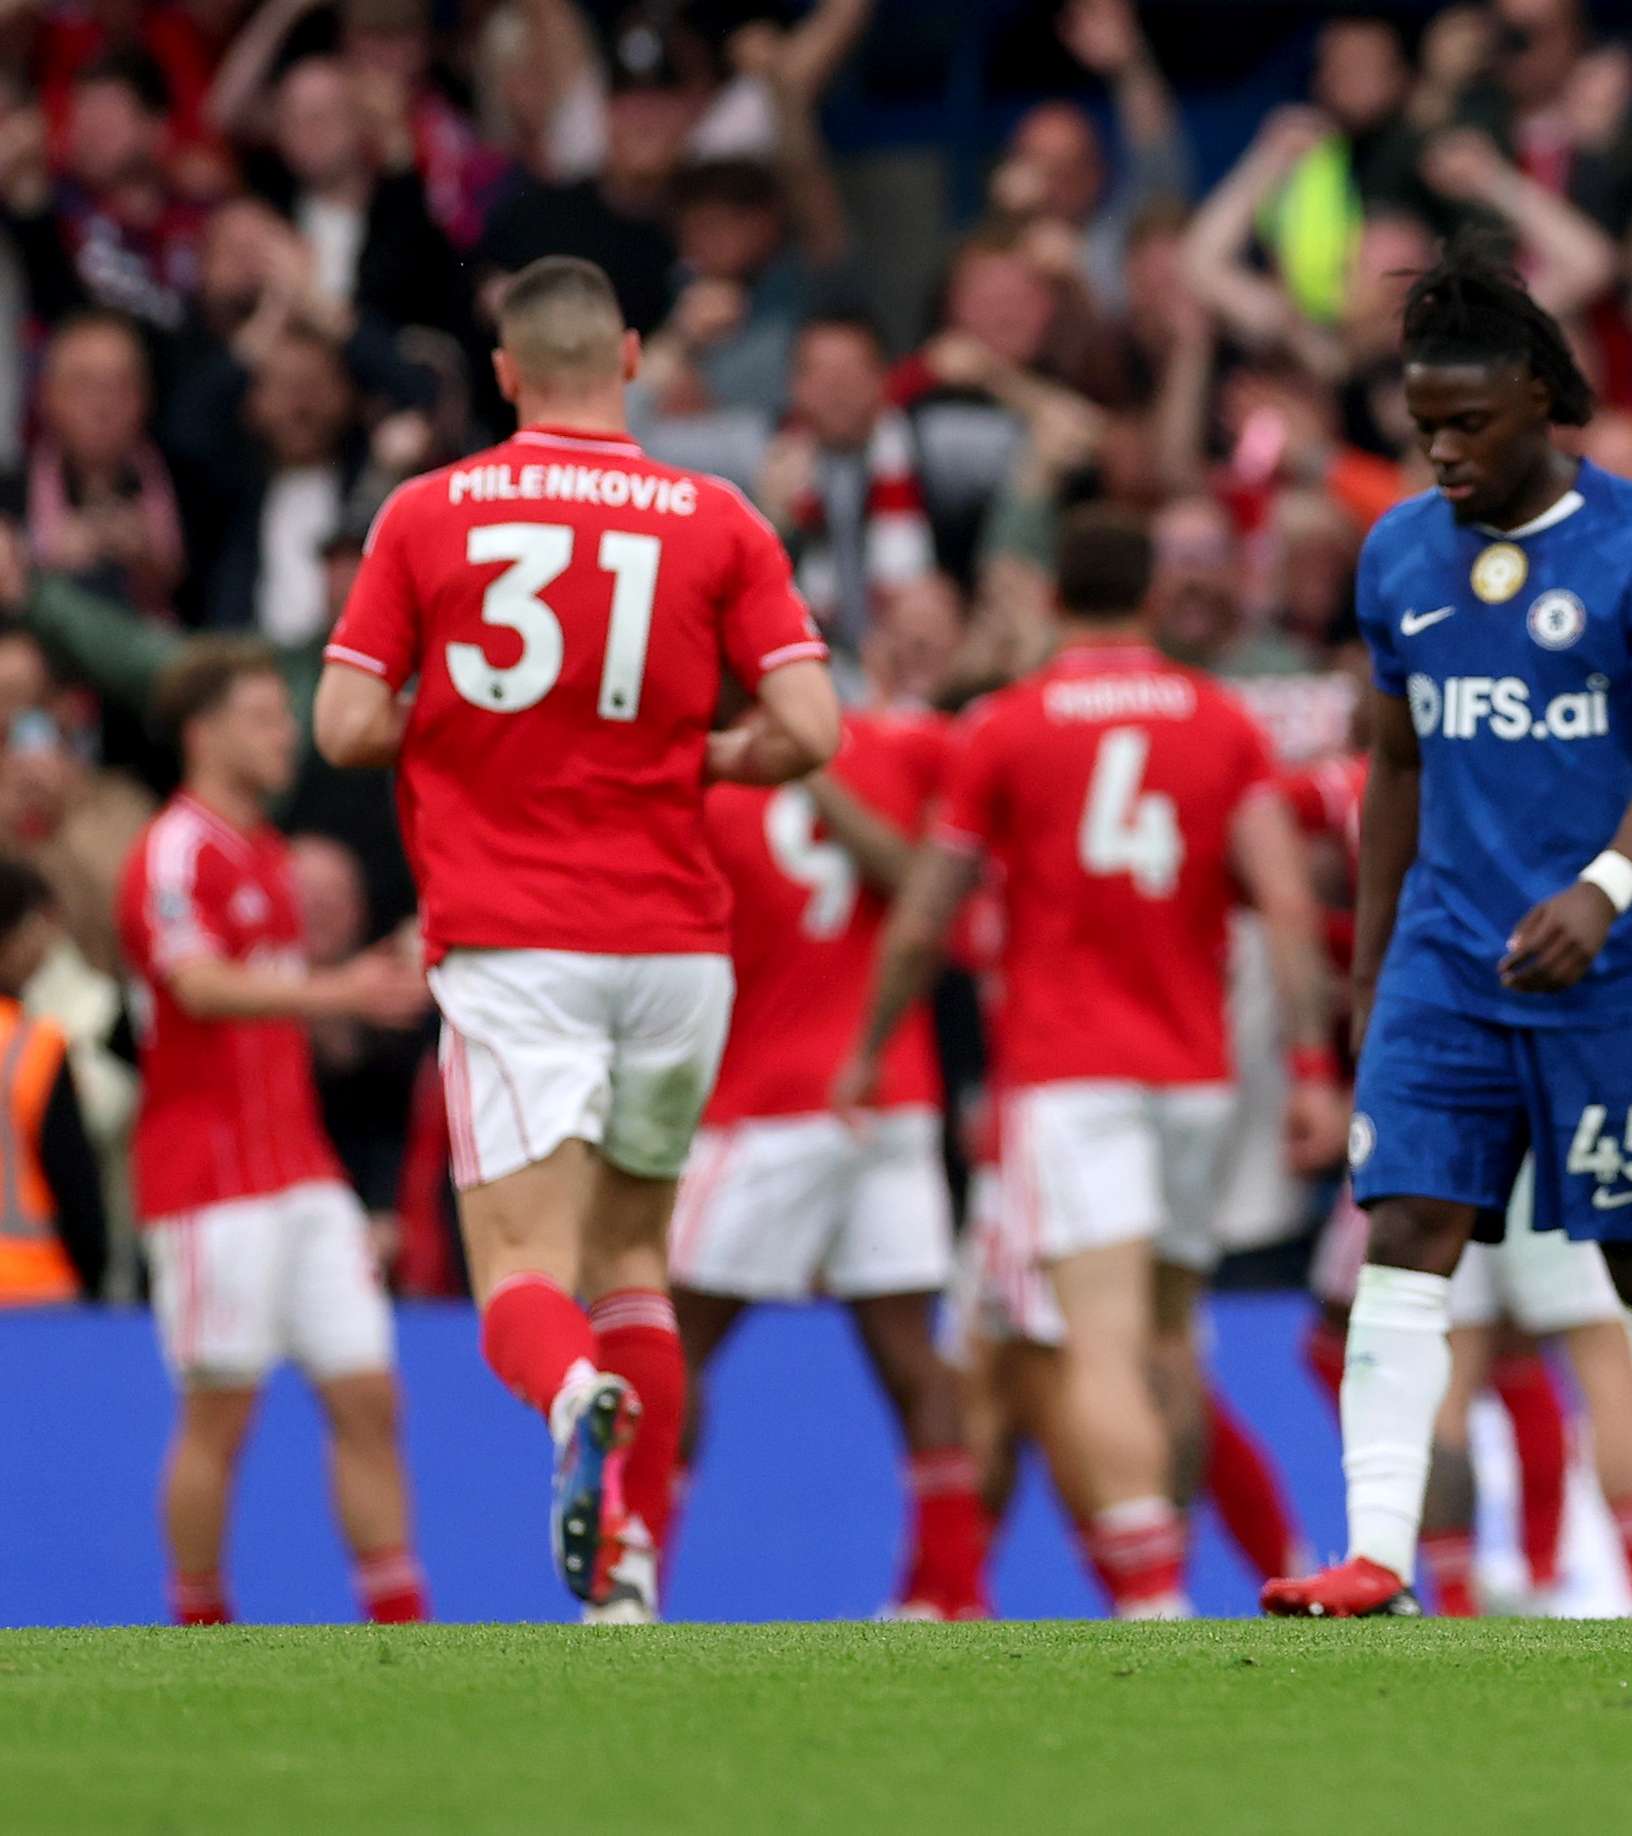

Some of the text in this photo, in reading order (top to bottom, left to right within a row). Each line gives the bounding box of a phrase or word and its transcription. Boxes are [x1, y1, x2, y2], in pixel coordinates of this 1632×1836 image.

[449, 463, 698, 517] MILENKOVIĆ
[445, 521, 662, 724] 31
[1442, 674, 1611, 741] IFS.ai
[1078, 726, 1184, 900] 4
